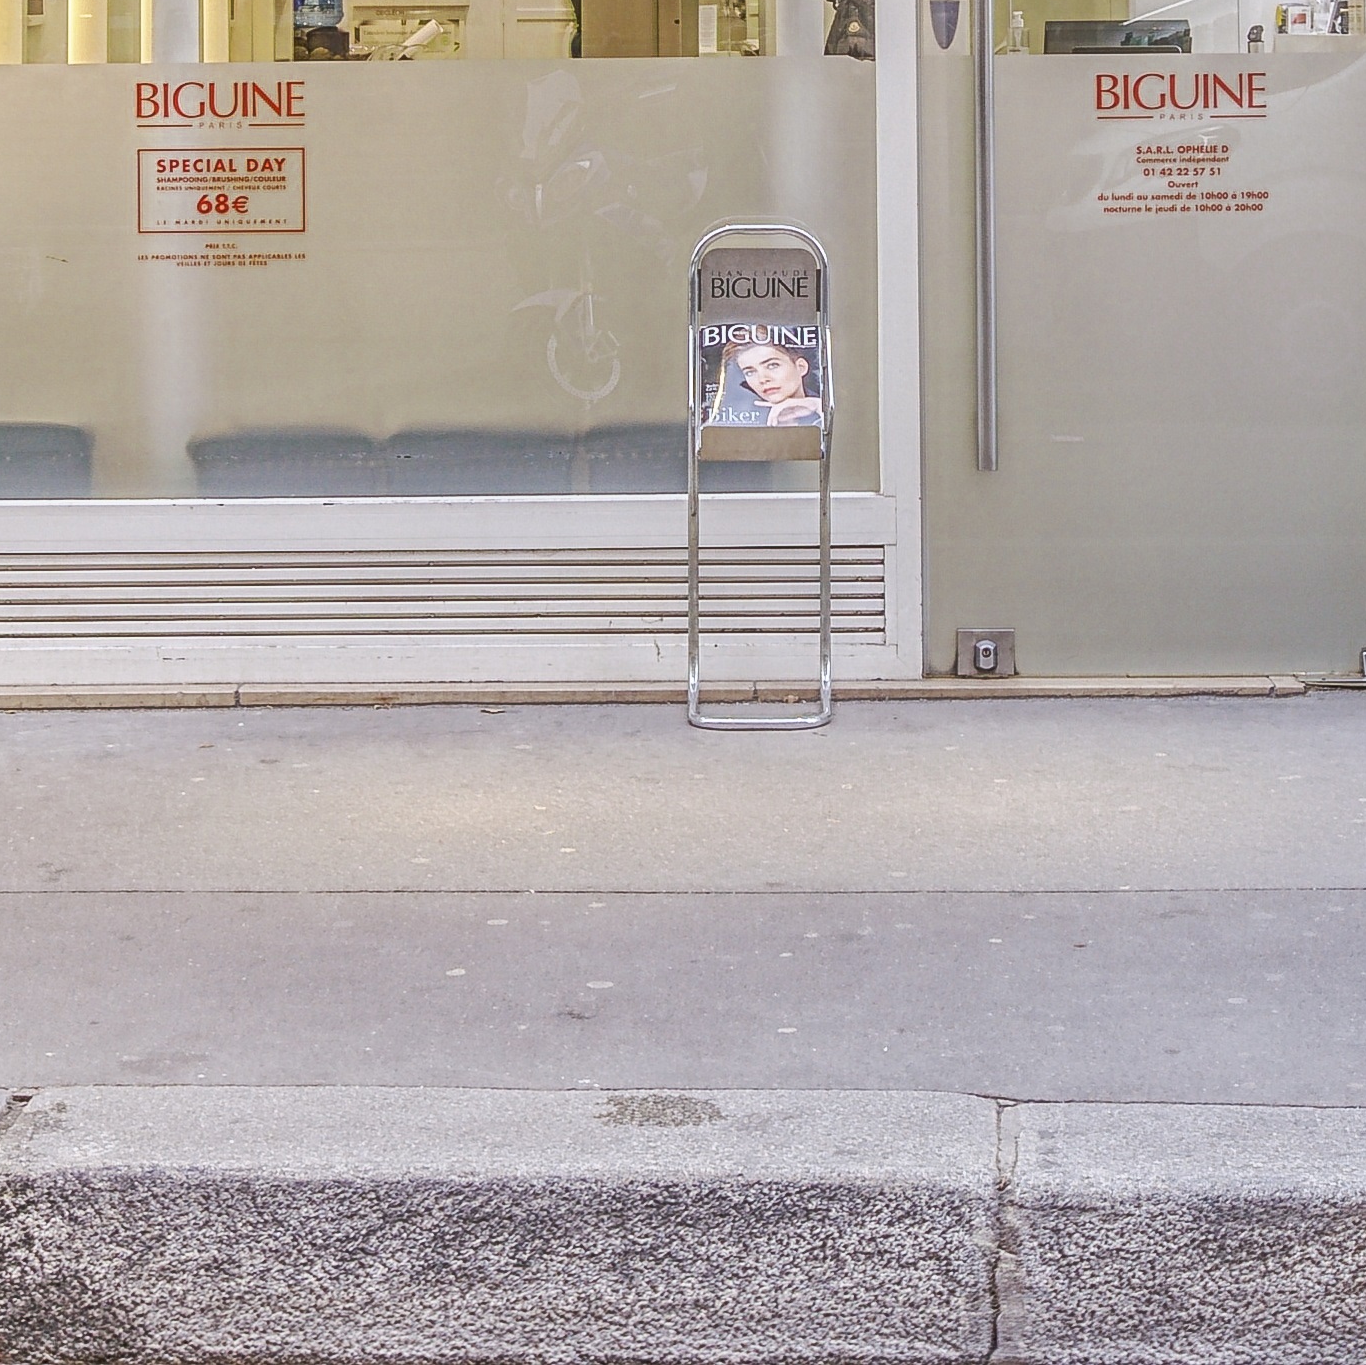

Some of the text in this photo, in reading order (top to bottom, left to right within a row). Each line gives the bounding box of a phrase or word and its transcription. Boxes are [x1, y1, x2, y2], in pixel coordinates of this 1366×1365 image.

[136, 81, 305, 119] BIGUINE
[1096, 73, 1266, 110] BIGUINE
[1137, 146, 1173, 154] S.A.R.L.
[1222, 145, 1228, 153] D
[157, 158, 286, 173] SPECIAL DAY
[1143, 167, 1221, 176] 01 42 22 57 51
[197, 194, 249, 214] 68€
[1186, 192, 1196, 200] de
[1201, 192, 1228, 200] 10h00
[1241, 191, 1268, 199] 19h00
[1155, 205, 1177, 214] jeudi
[1180, 204, 1191, 212] de
[1195, 204, 1222, 212] 10h00
[711, 277, 808, 298] BIGUINE
[703, 325, 816, 347] BIGUINE
